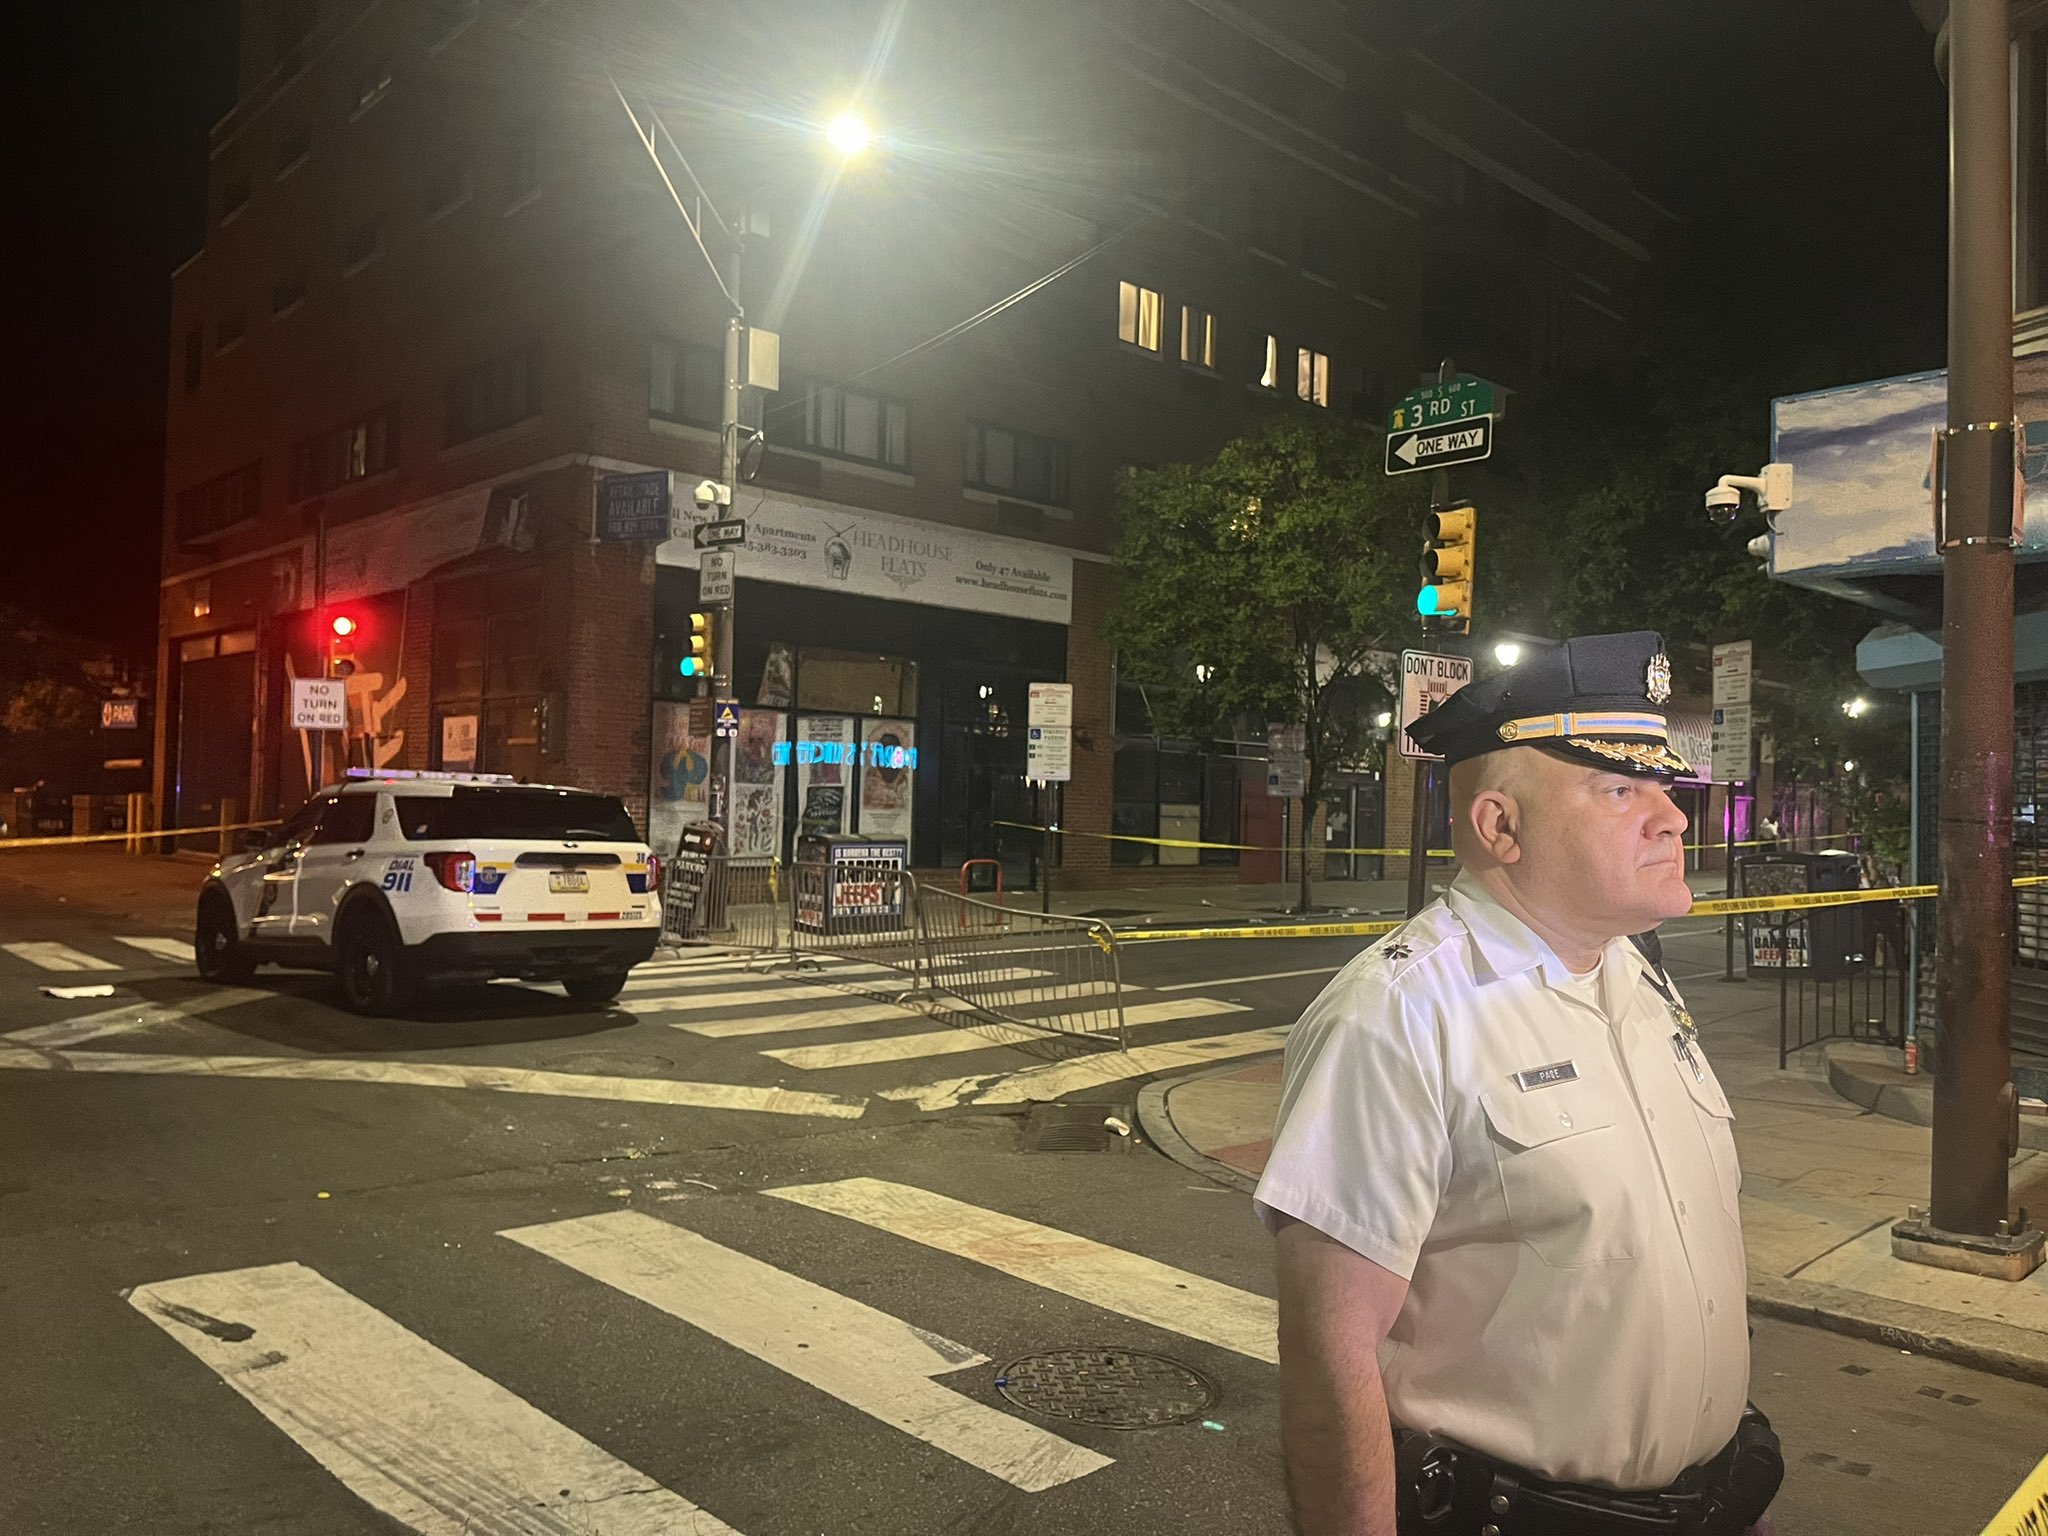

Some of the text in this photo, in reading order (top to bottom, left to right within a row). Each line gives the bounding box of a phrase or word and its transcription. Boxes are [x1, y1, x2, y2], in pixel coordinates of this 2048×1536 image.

[1410, 398, 1476, 428] 3 RD ST
[1416, 430, 1479, 455] ONE WAY
[608, 497, 660, 517] AVAILABLE
[722, 526, 740, 538] WAY
[752, 523, 817, 542] Apartments
[854, 530, 953, 562] HEADHOUSE
[710, 557, 723, 568] NO
[880, 555, 927, 578] FLATS
[707, 571, 728, 582] TURN
[975, 561, 1052, 583] Only 47 Available
[715, 584, 731, 596] RED
[1437, 661, 1469, 682] BLOCK
[309, 685, 330, 696] NO
[303, 697, 338, 709] TURN
[297, 712, 341, 725] ON RED
[388, 859, 414, 871] DIAL
[381, 872, 412, 892] 911
[1539, 1068, 1561, 1080] PAGE
